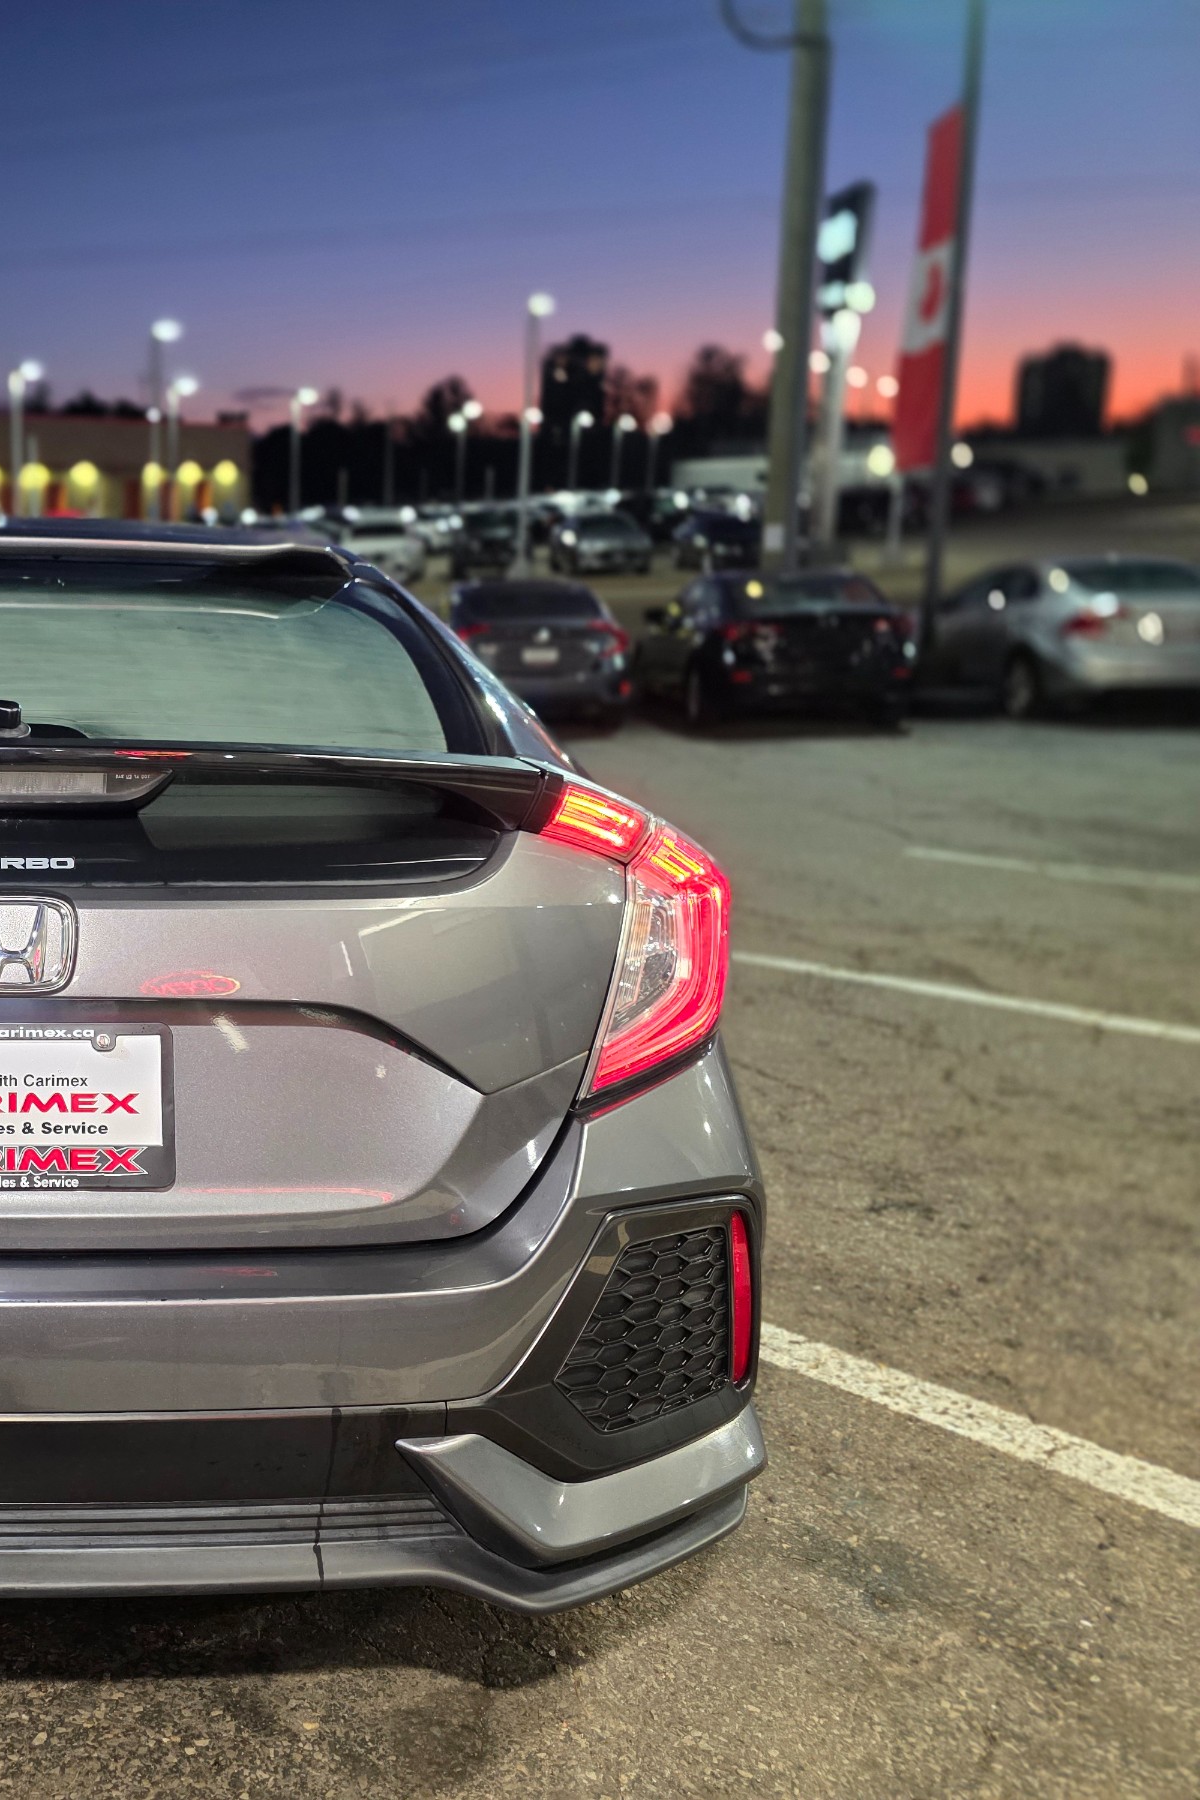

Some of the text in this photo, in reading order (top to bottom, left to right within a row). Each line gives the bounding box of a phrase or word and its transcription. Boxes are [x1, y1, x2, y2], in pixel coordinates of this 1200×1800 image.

[23, 1074, 88, 1088] Carimex
[21, 1121, 35, 1135] &
[41, 1121, 108, 1135] Service
[19, 1176, 31, 1189] &
[33, 1176, 79, 1189] Service
